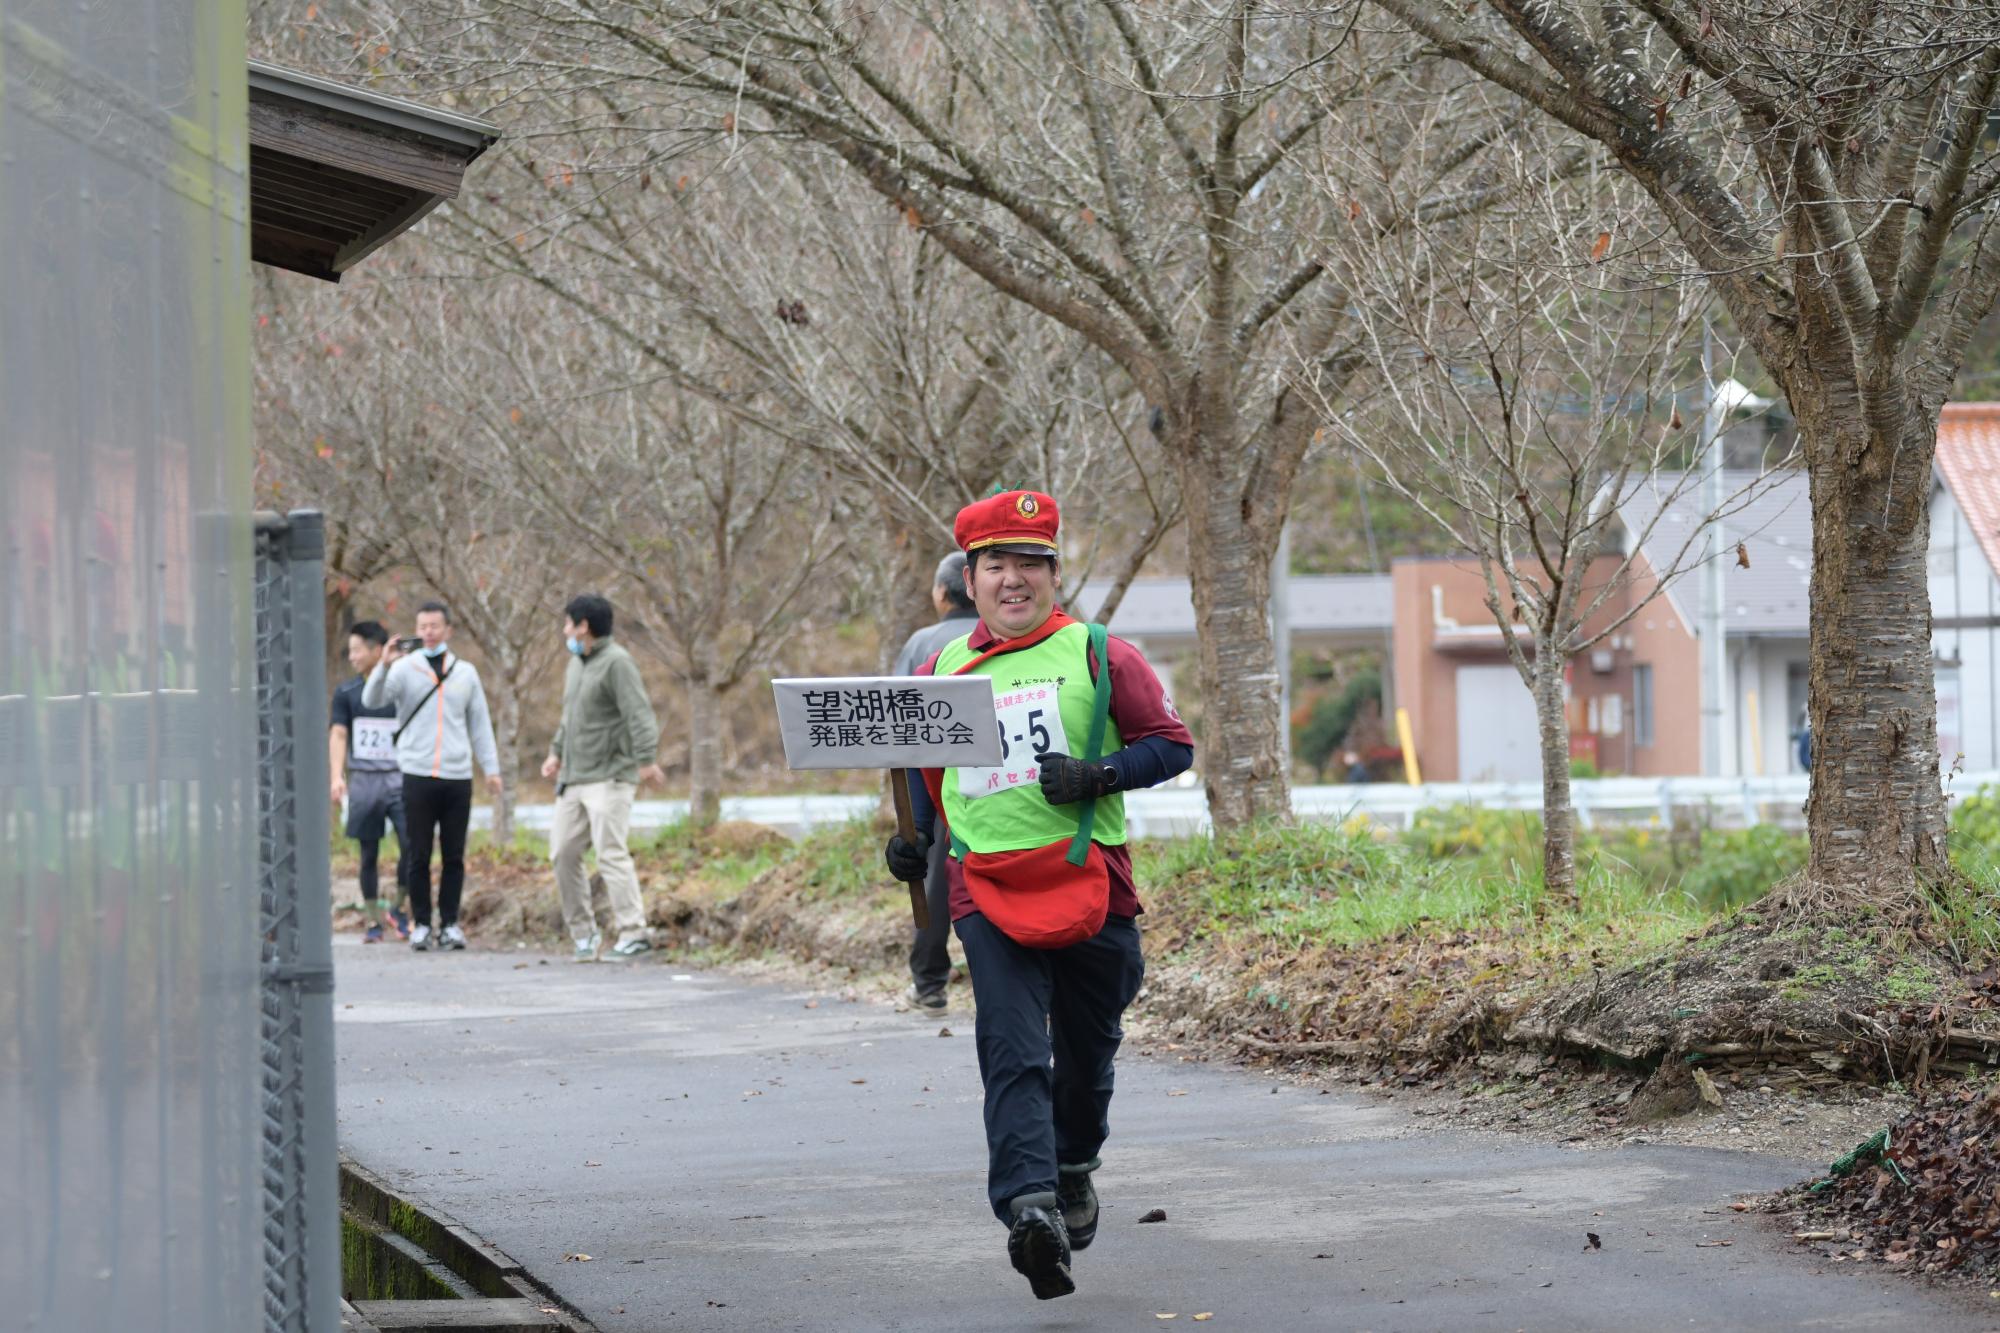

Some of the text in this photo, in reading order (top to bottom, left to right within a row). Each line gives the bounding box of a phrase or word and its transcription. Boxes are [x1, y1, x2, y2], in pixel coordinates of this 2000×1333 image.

[803, 688, 952, 723] 望湖橋の
[810, 722, 974, 747] 発展を望む会
